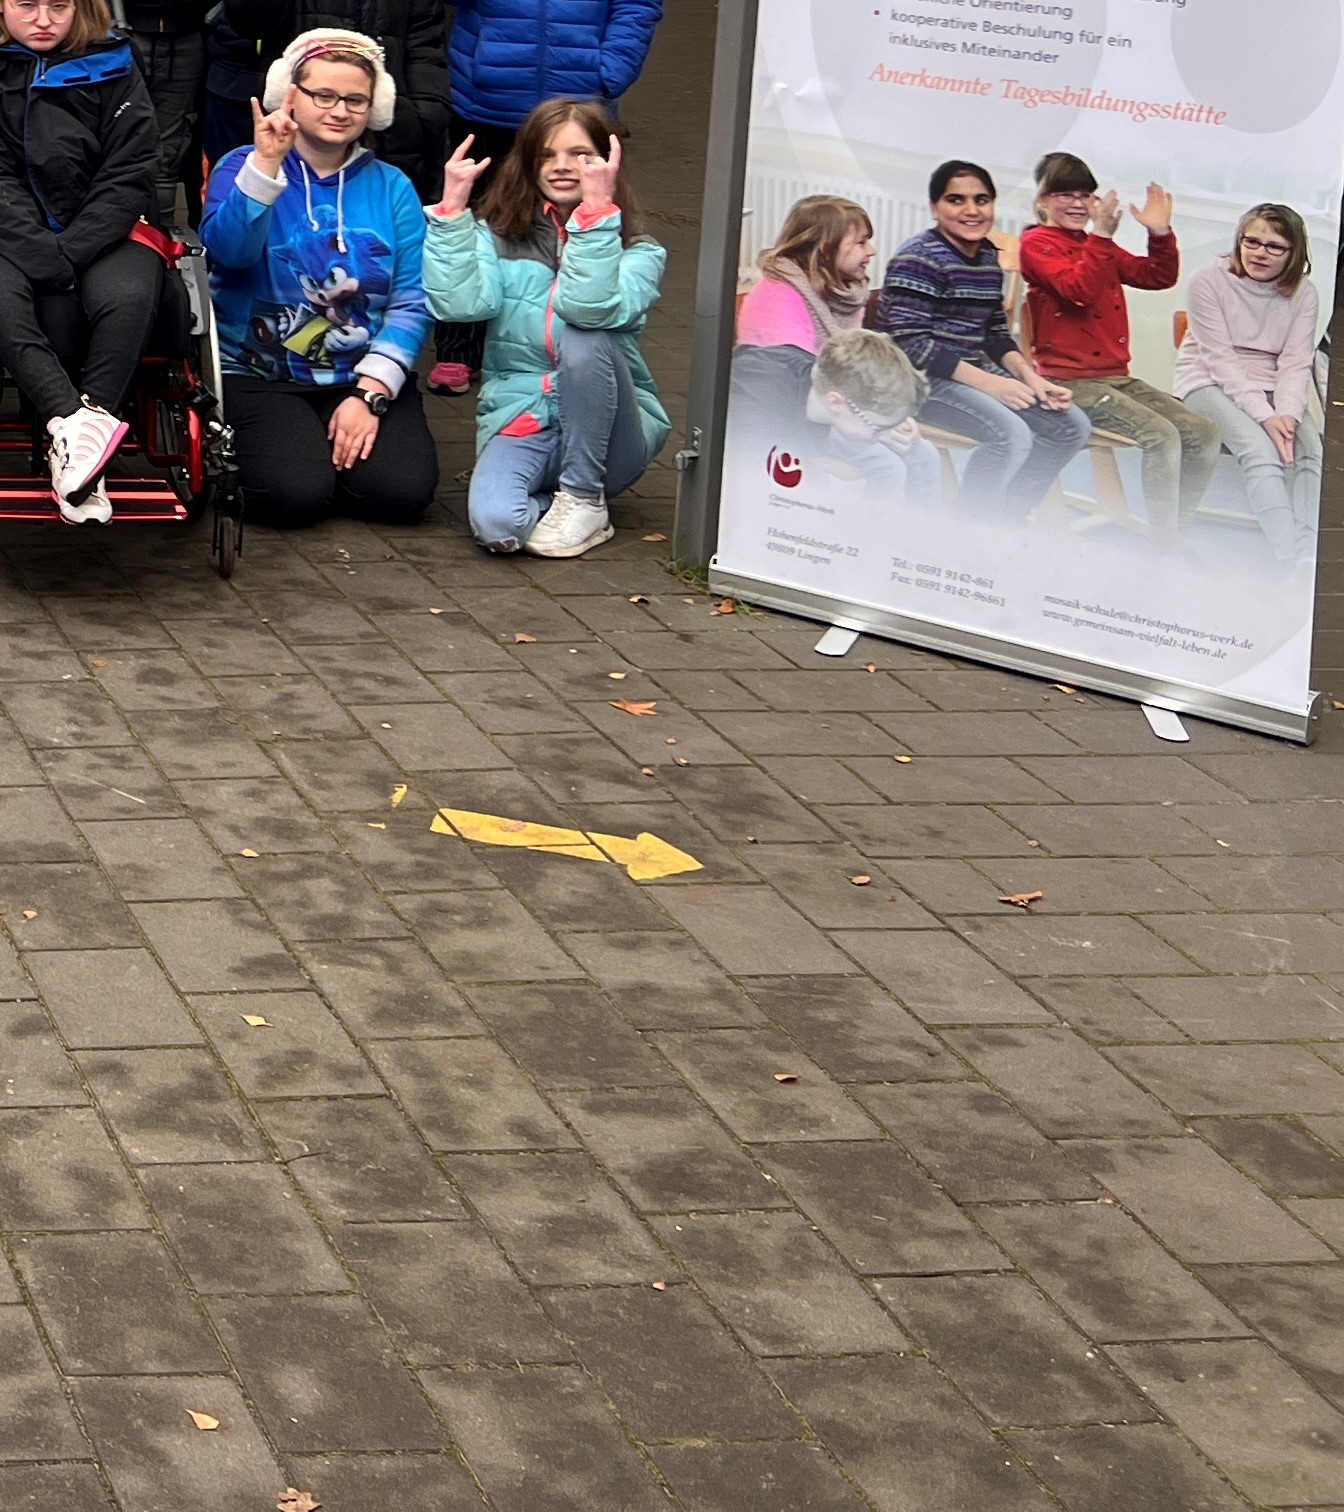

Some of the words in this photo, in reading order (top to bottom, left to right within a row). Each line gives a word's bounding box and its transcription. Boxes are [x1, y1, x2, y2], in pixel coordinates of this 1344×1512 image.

[890, 8, 978, 31] kooperative
[981, 20, 1074, 44] Beschulung
[1078, 29, 1103, 44] für
[1107, 34, 1132, 48] ein
[888, 31, 957, 53] inklusives
[961, 41, 1060, 64] Miteinander
[866, 62, 993, 96] Anerkannte
[1000, 78, 1227, 125] Tagesbildungsstätte
[797, 548, 831, 565] Lingen
[846, 546, 860, 557] 22
[916, 563, 942, 577] 0591
[915, 577, 941, 592] 0591
